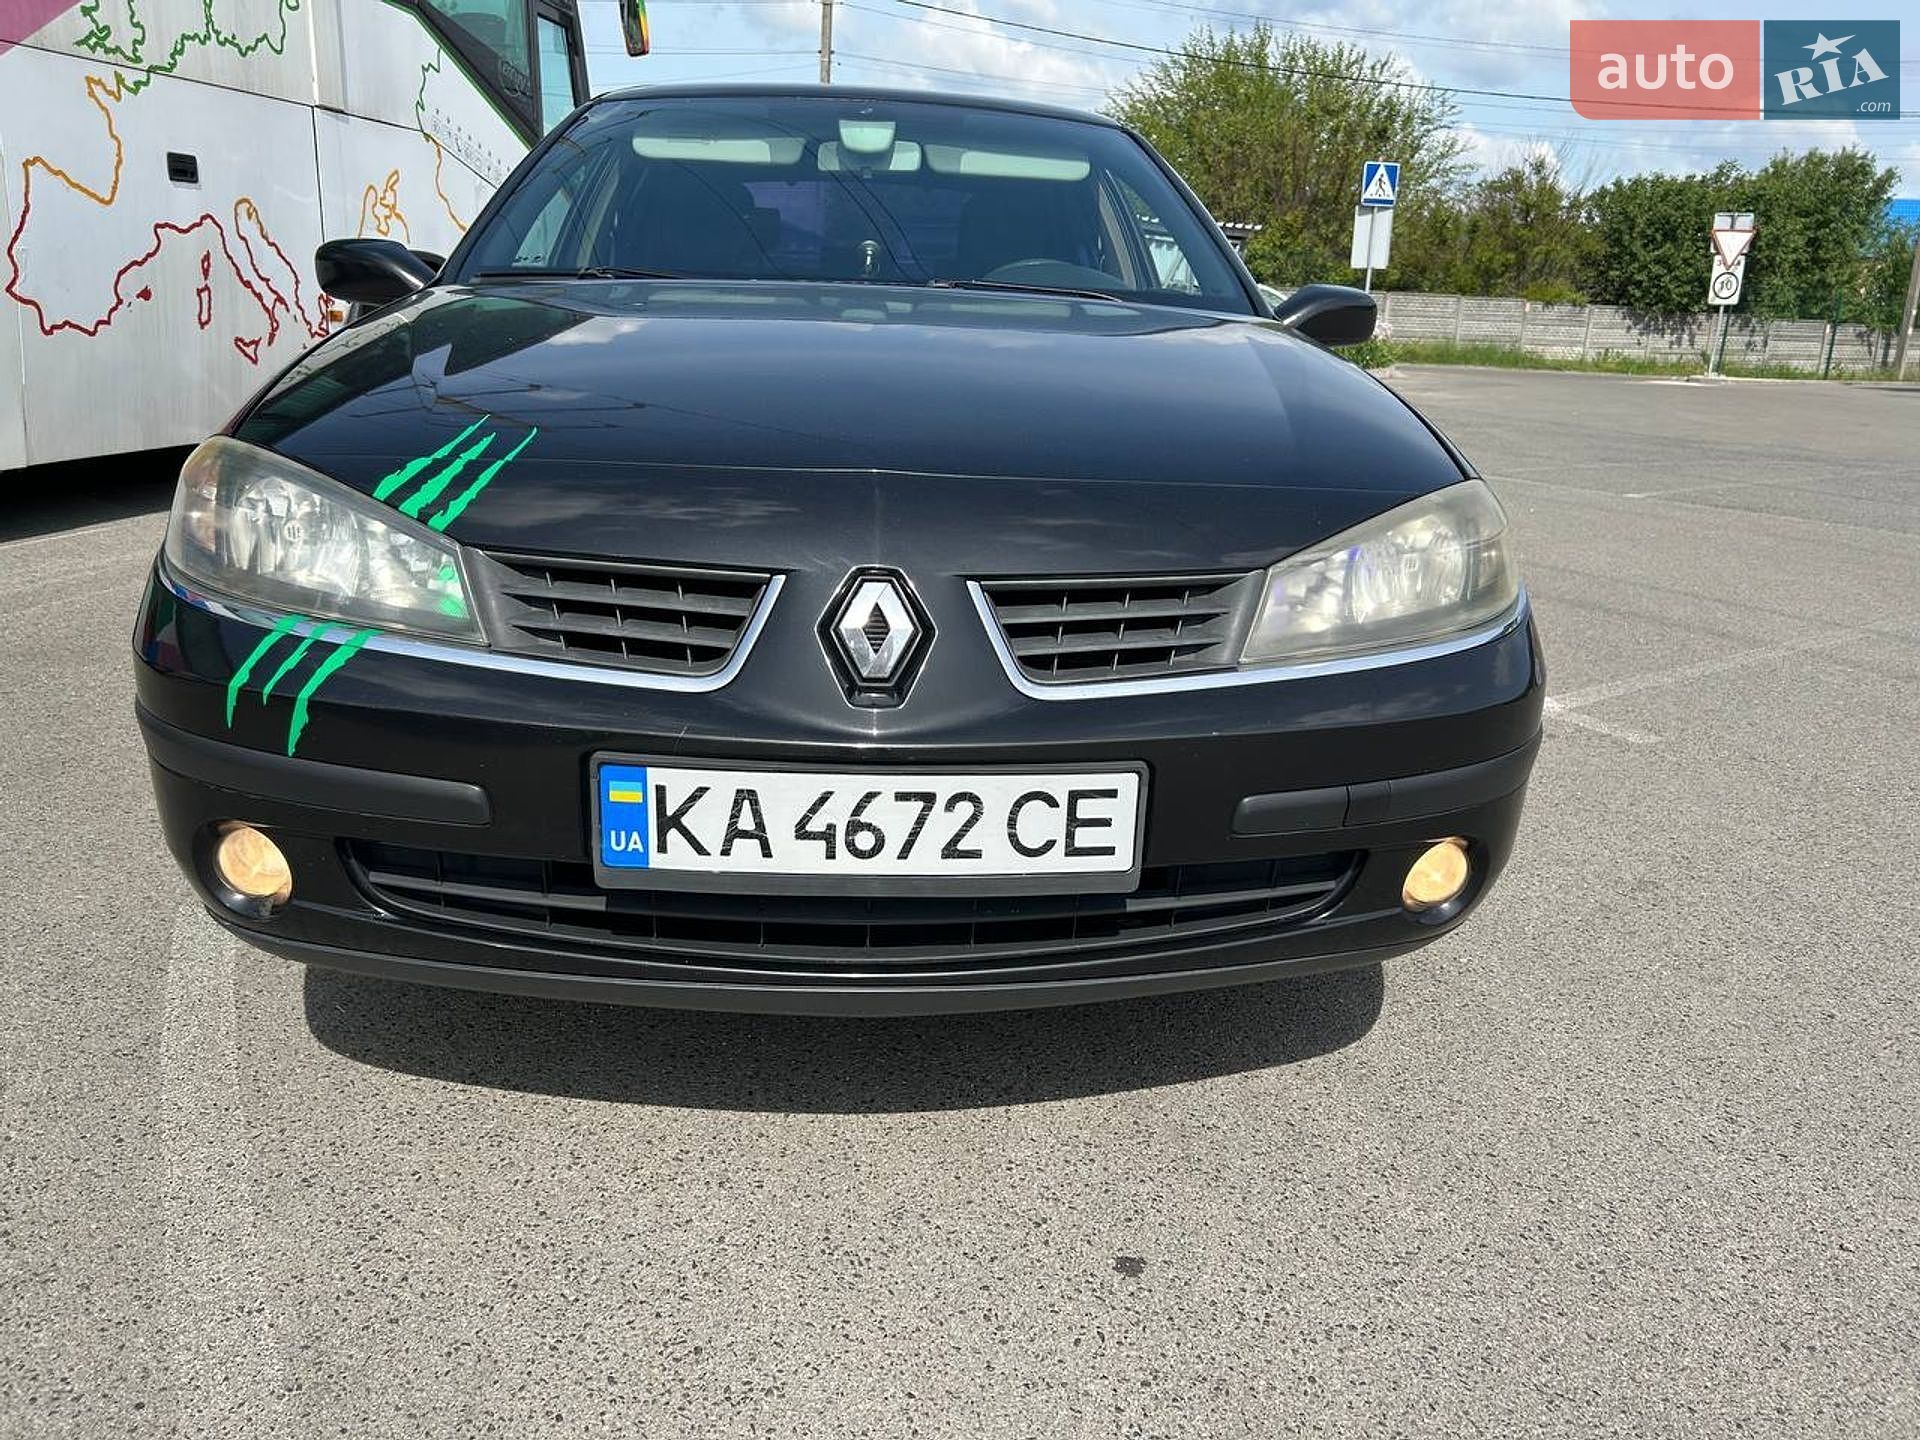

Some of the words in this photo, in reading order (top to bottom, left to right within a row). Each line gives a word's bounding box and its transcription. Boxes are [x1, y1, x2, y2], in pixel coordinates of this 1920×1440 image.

[610, 830, 644, 853] UA
[654, 784, 774, 859] KA
[794, 790, 984, 861] 4672
[1006, 788, 1119, 858] CE
